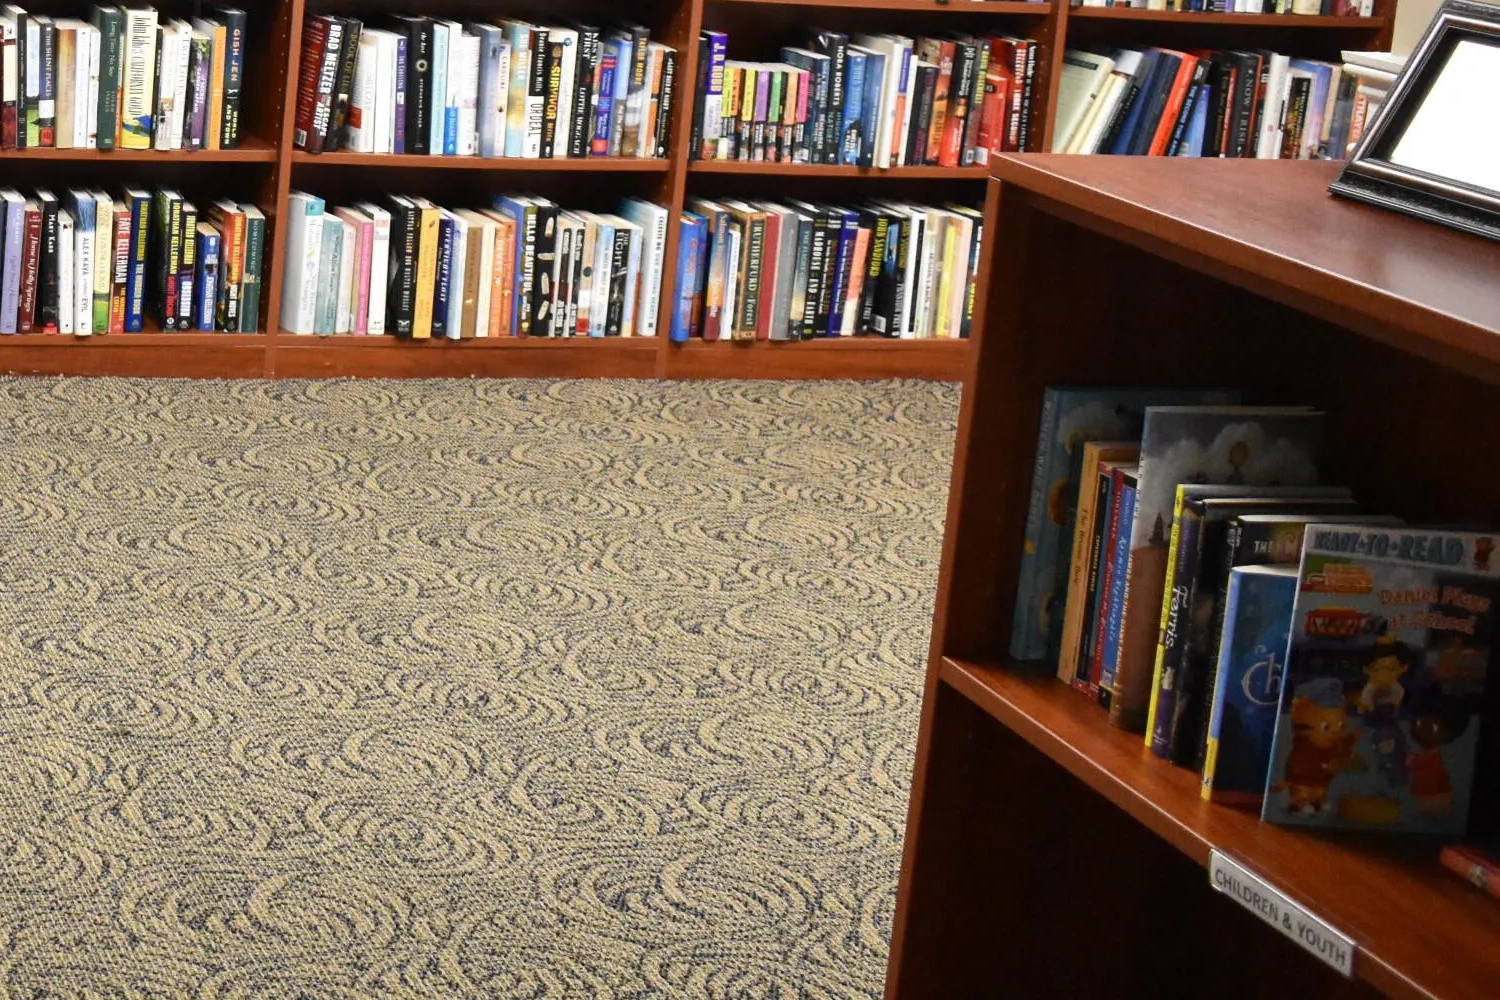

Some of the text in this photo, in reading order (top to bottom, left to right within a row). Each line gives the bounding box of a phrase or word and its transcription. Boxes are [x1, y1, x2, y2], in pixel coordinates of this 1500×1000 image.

[230, 28, 241, 81] GISH JEN
[319, 24, 342, 94] BRAD MELTZER
[710, 43, 724, 92] J. D. ROBB
[832, 46, 844, 106] NORA ROBERTS
[312, 102, 324, 130] ARTIST
[319, 108, 330, 137] ESCAPE
[528, 102, 543, 137] ORDEAL
[546, 66, 561, 120] SURVIVOR
[115, 217, 130, 283] FAYE KELLERMAN
[169, 202, 181, 275] JONATHAN KELLERMAN
[522, 214, 537, 293] HELLO BEAUTIFUL
[869, 218, 888, 277] JOHN SANDFORD
[745, 226, 763, 325] RUTHERFURD Forest
[1215, 869, 1346, 966] CHILDREN & YOUTH
